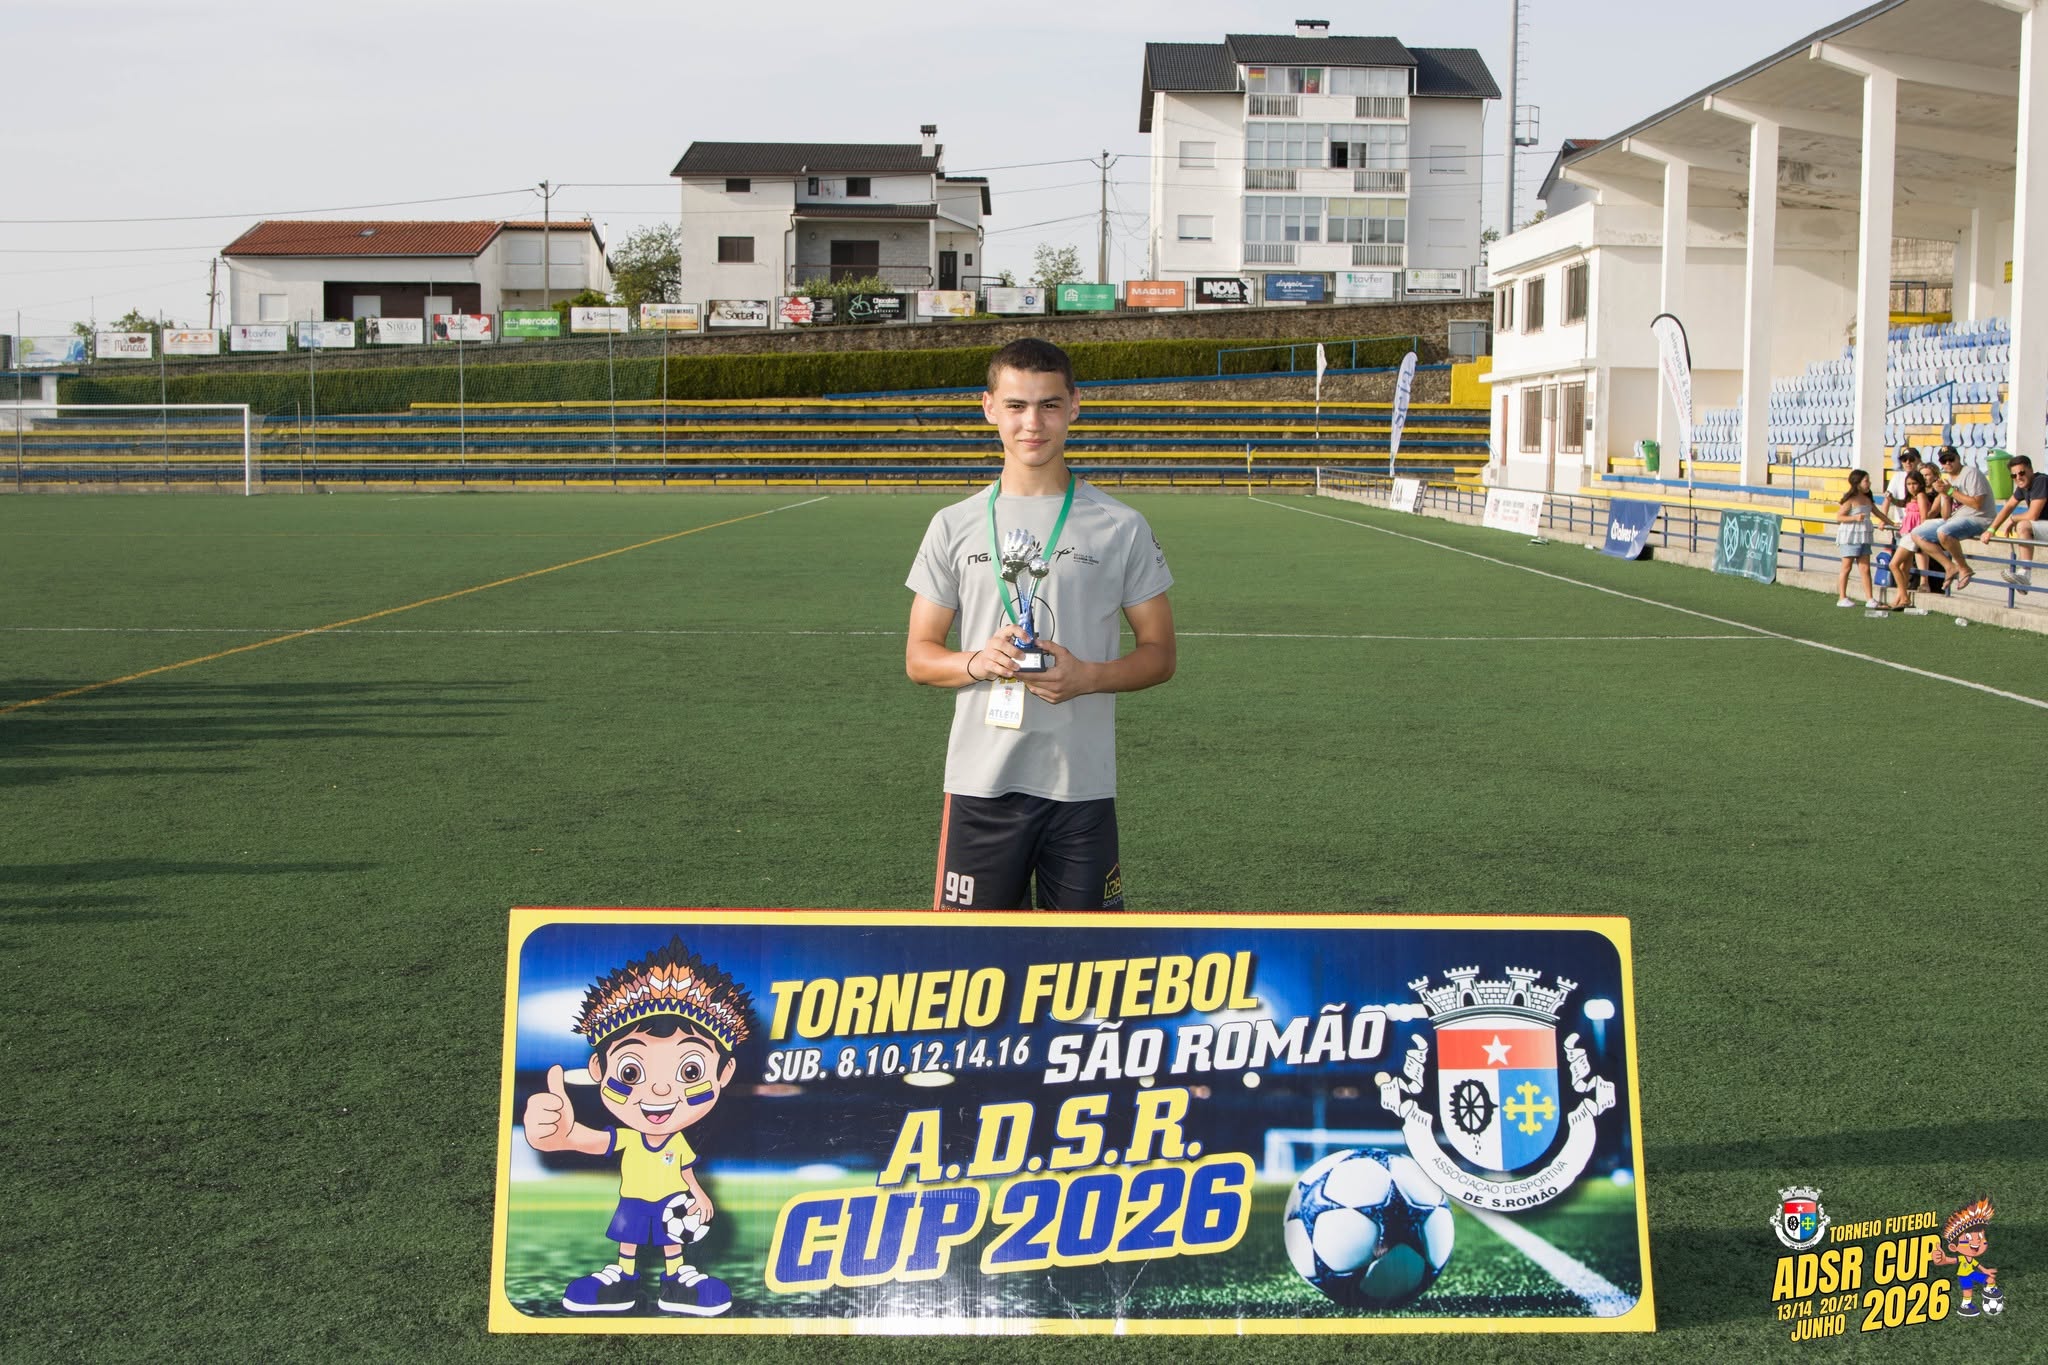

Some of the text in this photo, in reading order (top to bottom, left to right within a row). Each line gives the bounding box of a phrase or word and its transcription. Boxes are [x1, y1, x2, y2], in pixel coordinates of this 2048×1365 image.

[1131, 288, 1176, 296] MAGUIR
[1353, 273, 1383, 284] tavfer
[519, 316, 558, 326] mercado
[945, 871, 975, 905] 99
[769, 951, 1260, 1041] TORNEIO FUTEBOL
[764, 1034, 1032, 1084] SUB. 8.10.12.14.16
[1043, 1002, 1388, 1085] SÃO ROMÃO
[877, 1086, 1202, 1188] A.D.S.R.
[1504, 1159, 1568, 1196] DESPORTIVA
[1463, 1186, 1559, 1208] DE S.ROMÃO
[770, 1159, 1250, 1288] CUP 2026
